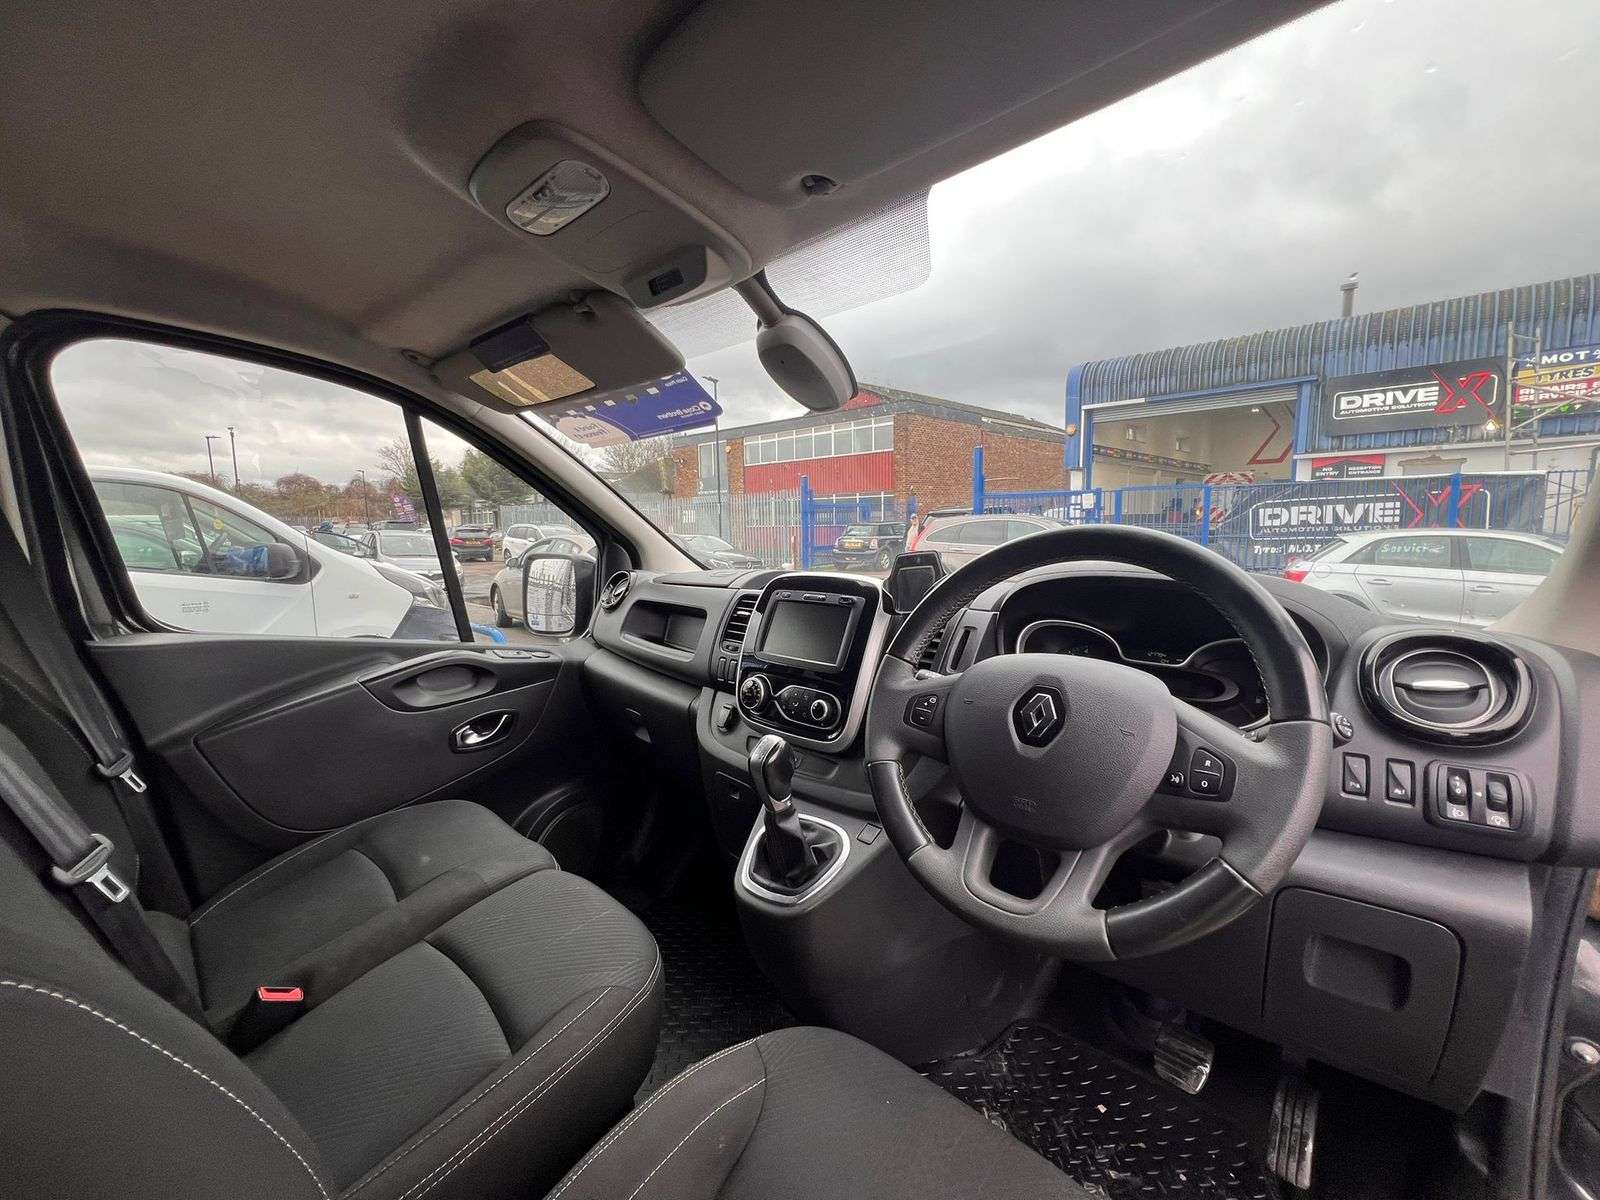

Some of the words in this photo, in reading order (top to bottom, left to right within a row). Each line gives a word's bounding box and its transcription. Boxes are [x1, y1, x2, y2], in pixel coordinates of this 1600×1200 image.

[1541, 350, 1591, 365] MOT
[1340, 386, 1440, 410] DRIVE
[1339, 406, 1390, 415] AUTOMOTIVE
[1391, 401, 1438, 410] SOLUTIONS
[1259, 501, 1401, 527] DRIVE
